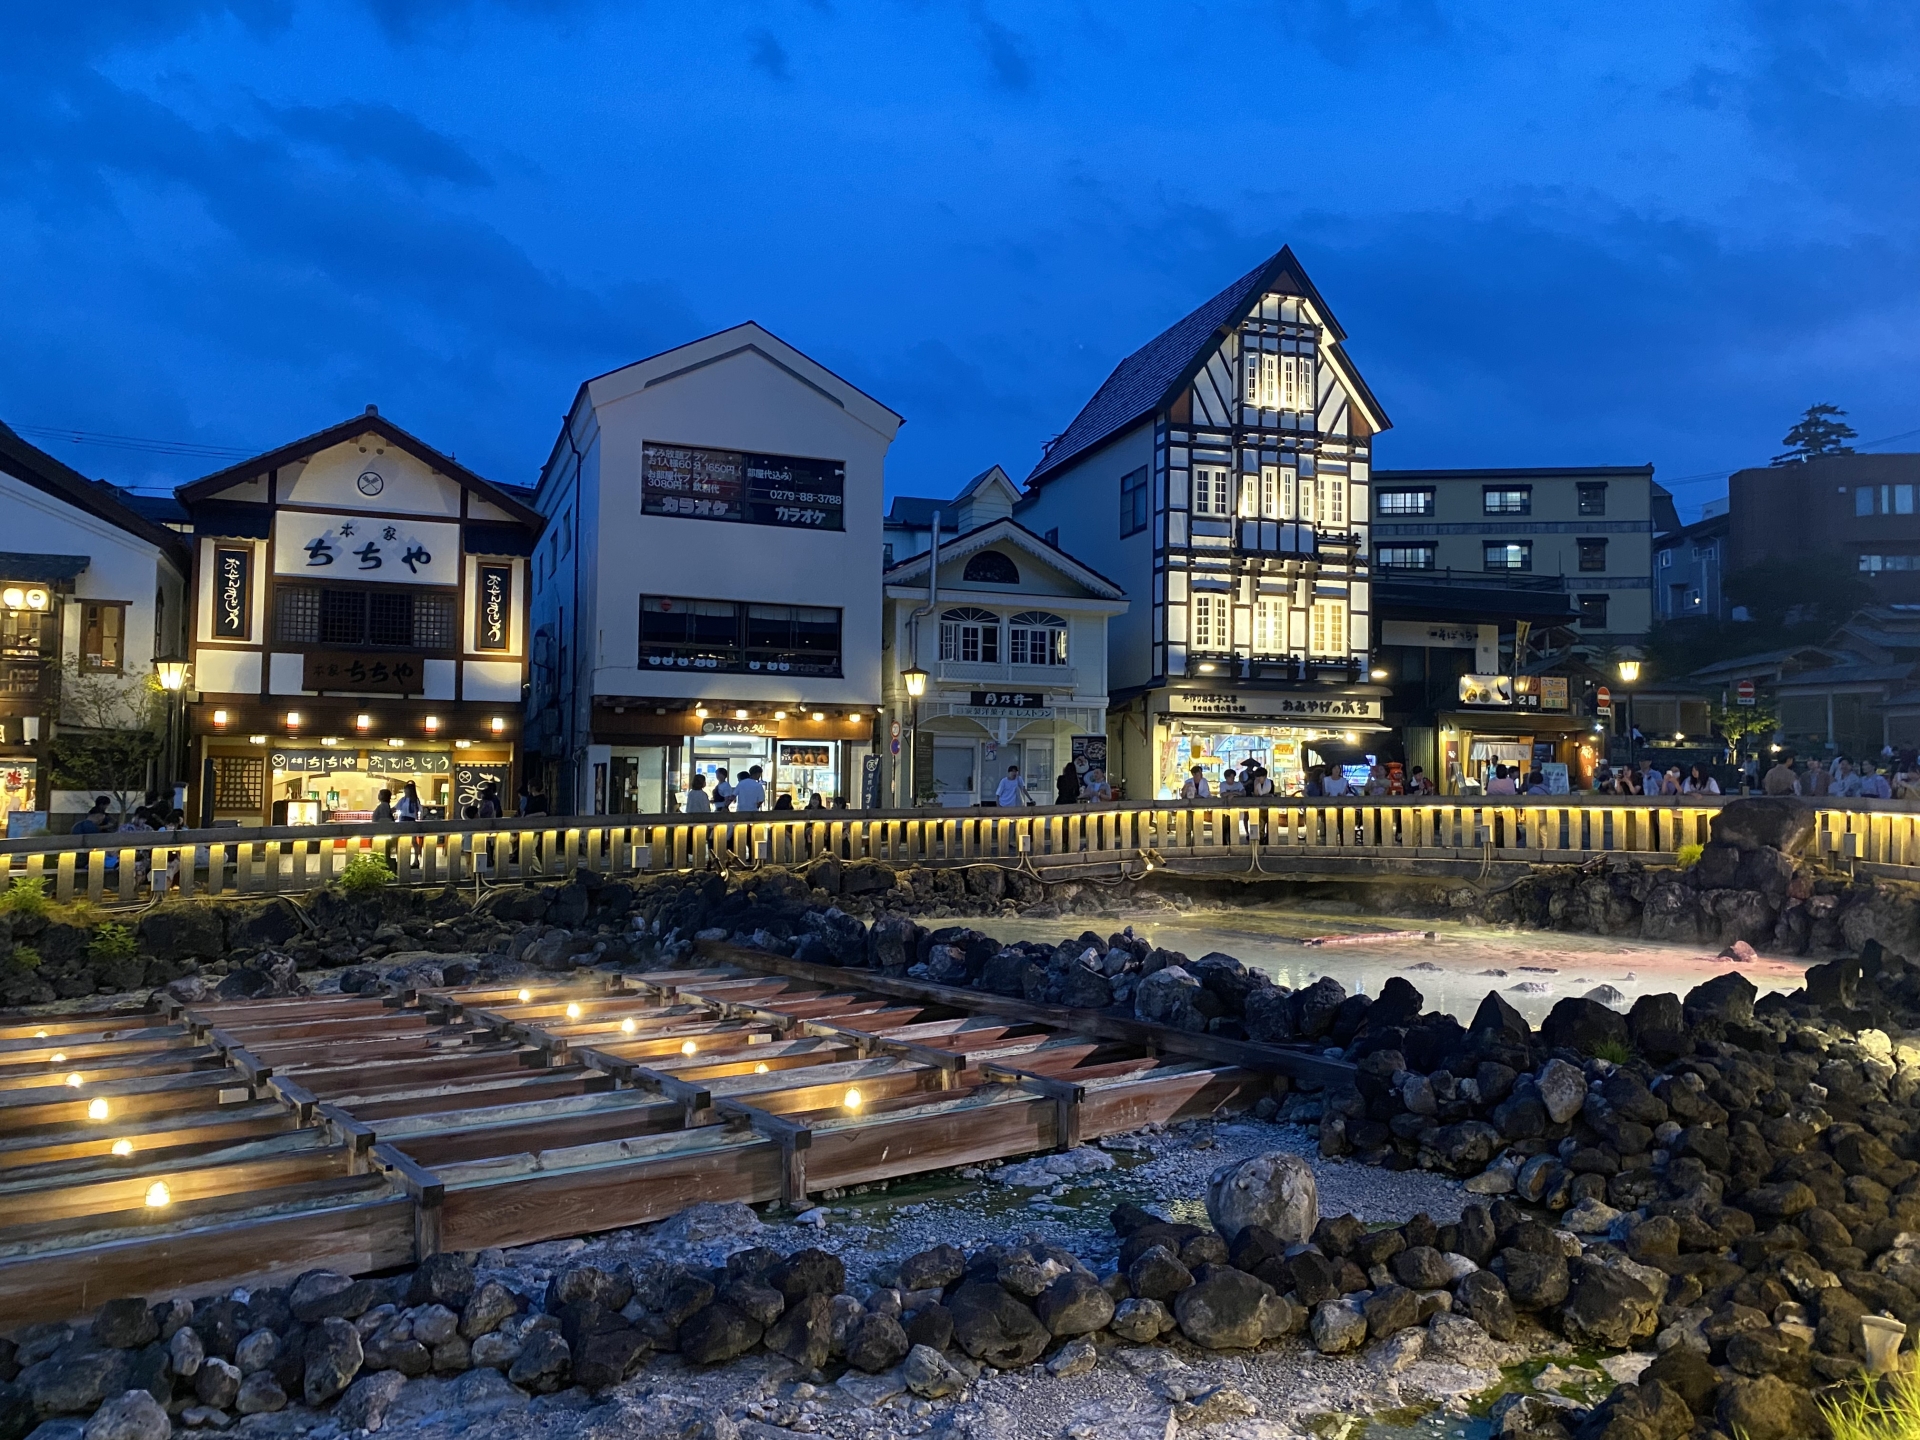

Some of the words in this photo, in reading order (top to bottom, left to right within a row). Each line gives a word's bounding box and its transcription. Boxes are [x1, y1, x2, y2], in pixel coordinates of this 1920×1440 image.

[705, 463, 735, 474] 1650円
[662, 496, 728, 516] カラオケ
[769, 489, 842, 505] 0279-88-3788
[775, 506, 826, 525] カラオケ
[339, 523, 397, 541] 本家
[303, 538, 432, 574] ちちや
[1518, 695, 1538, 706] 2階
